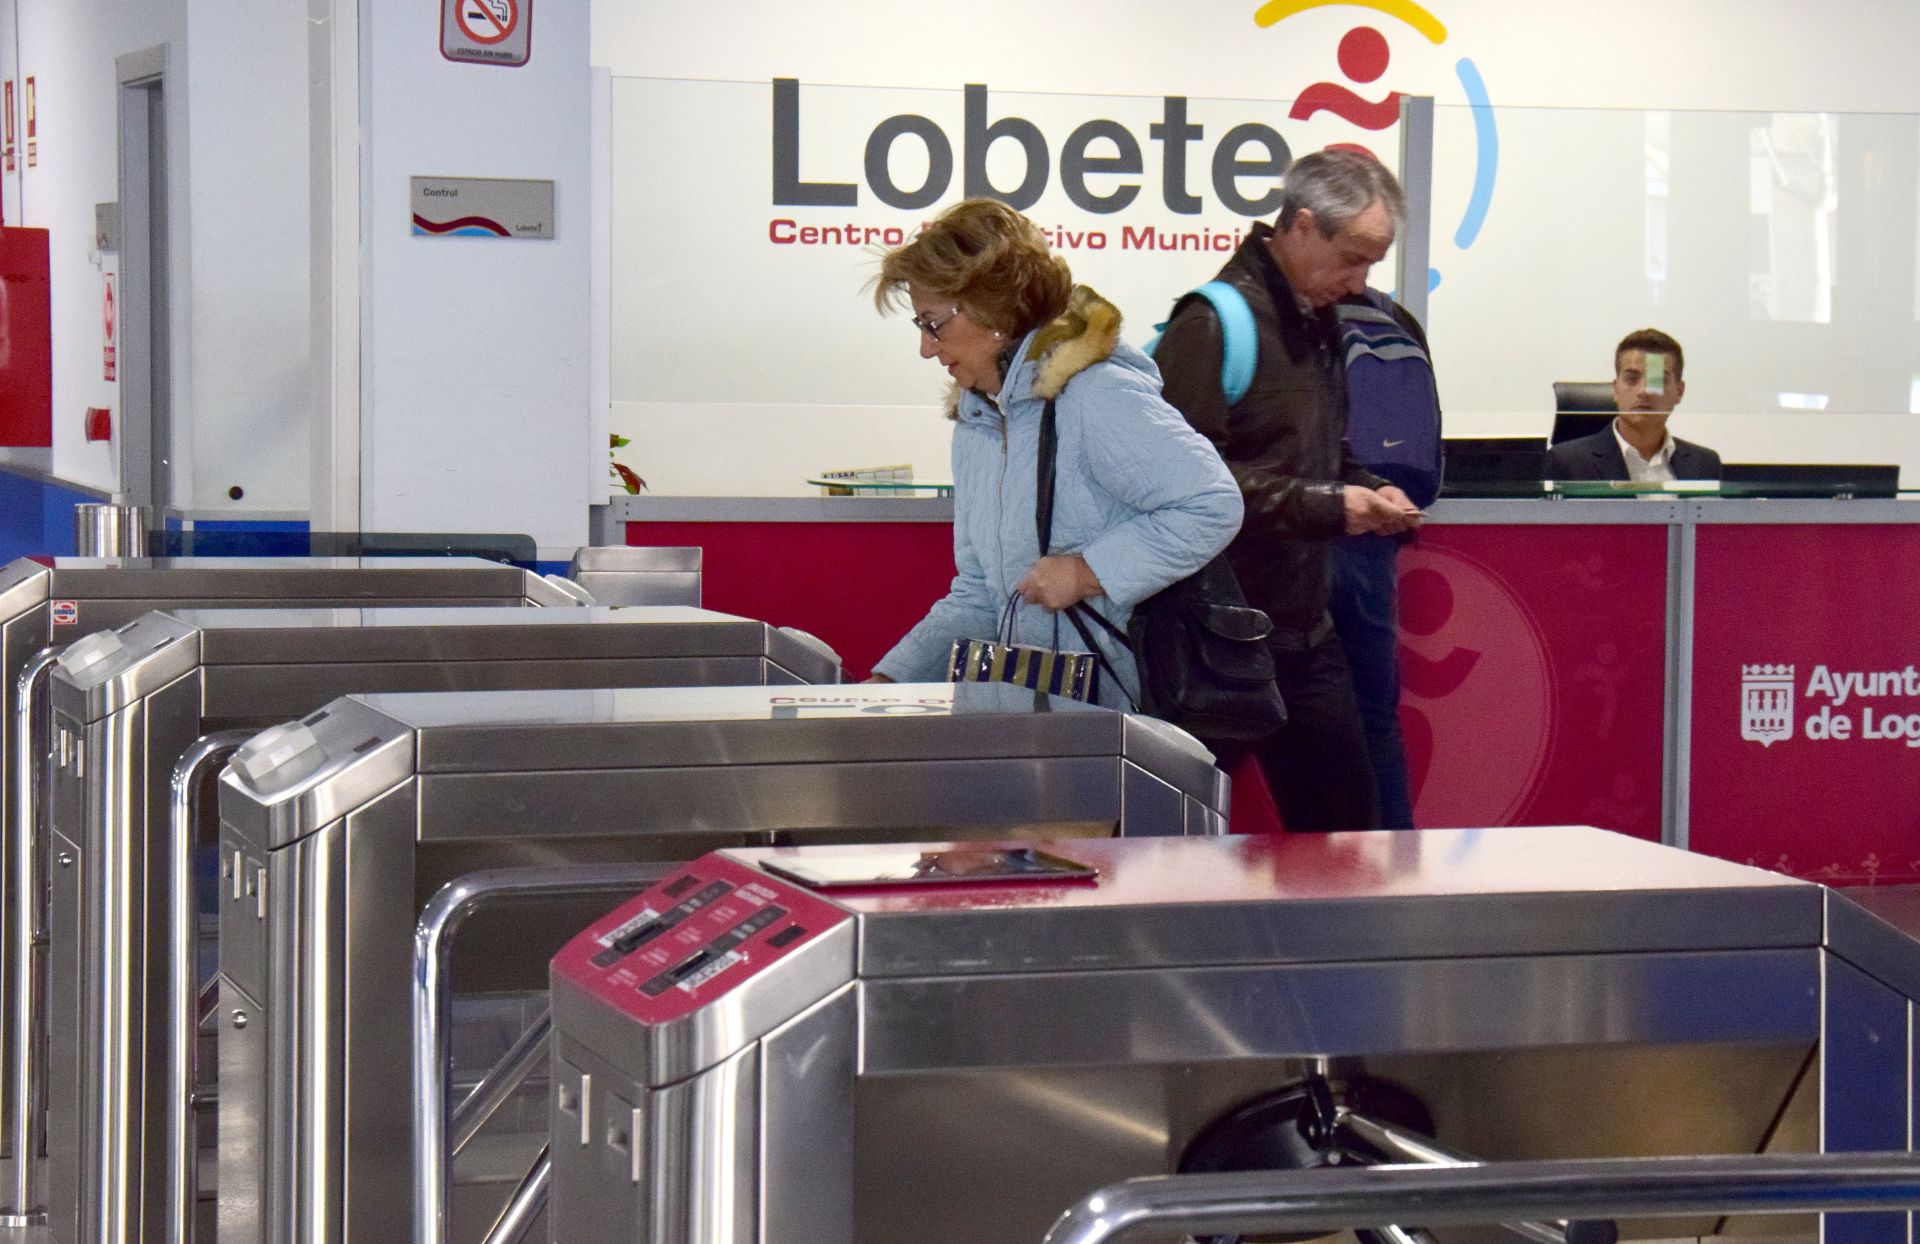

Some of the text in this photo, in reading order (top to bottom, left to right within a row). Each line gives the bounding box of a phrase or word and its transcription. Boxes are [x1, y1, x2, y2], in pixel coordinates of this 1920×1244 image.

[772, 78, 1293, 217] Lobete
[423, 187, 458, 197] Control
[769, 219, 904, 245] Centro
[1122, 225, 1241, 252] Munici
[1805, 665, 1920, 706] Ayunt
[1805, 706, 1920, 747] de Log
